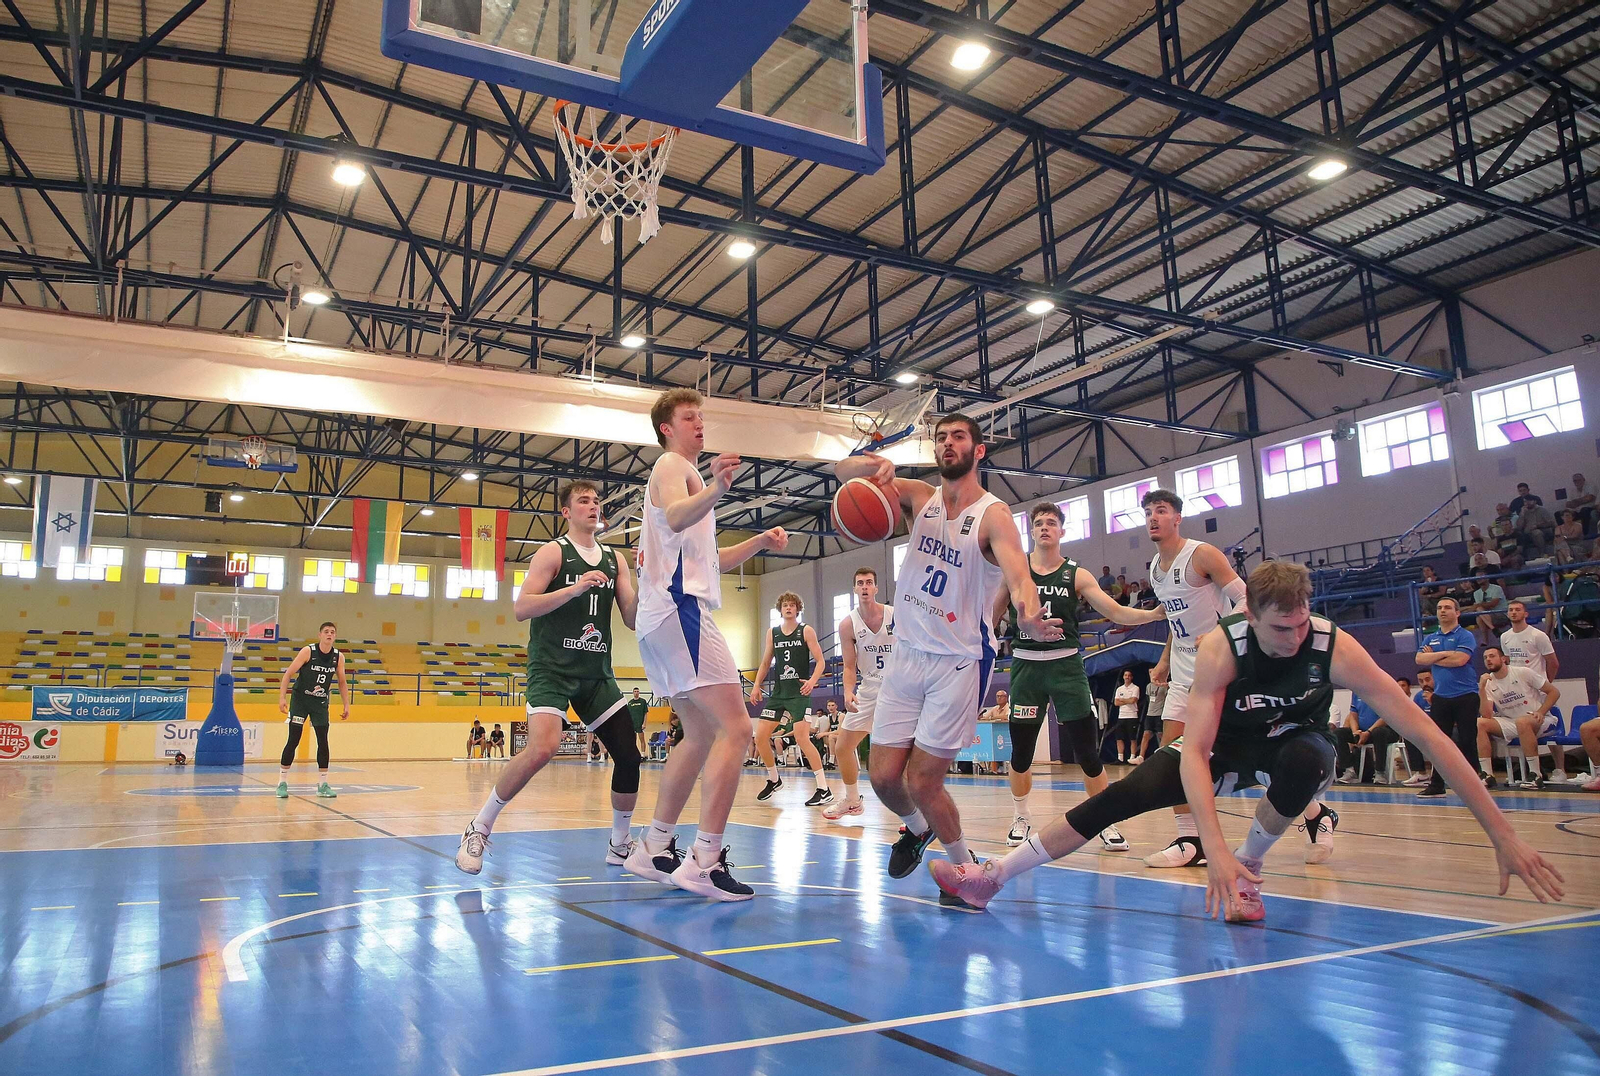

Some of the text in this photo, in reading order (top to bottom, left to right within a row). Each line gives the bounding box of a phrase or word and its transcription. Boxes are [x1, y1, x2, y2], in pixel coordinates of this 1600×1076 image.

[917, 535, 962, 568] ISRAEL
[921, 565, 948, 597] 20
[589, 593, 598, 616] 11
[563, 638, 607, 653] BIOVELA
[774, 640, 802, 648] LIETUVA
[784, 650, 791, 662] 3
[876, 656, 885, 669] 5
[316, 673, 327, 684] 13
[77, 693, 184, 704] Diputación DEPORTES
[76, 706, 120, 716] de Cádiz
